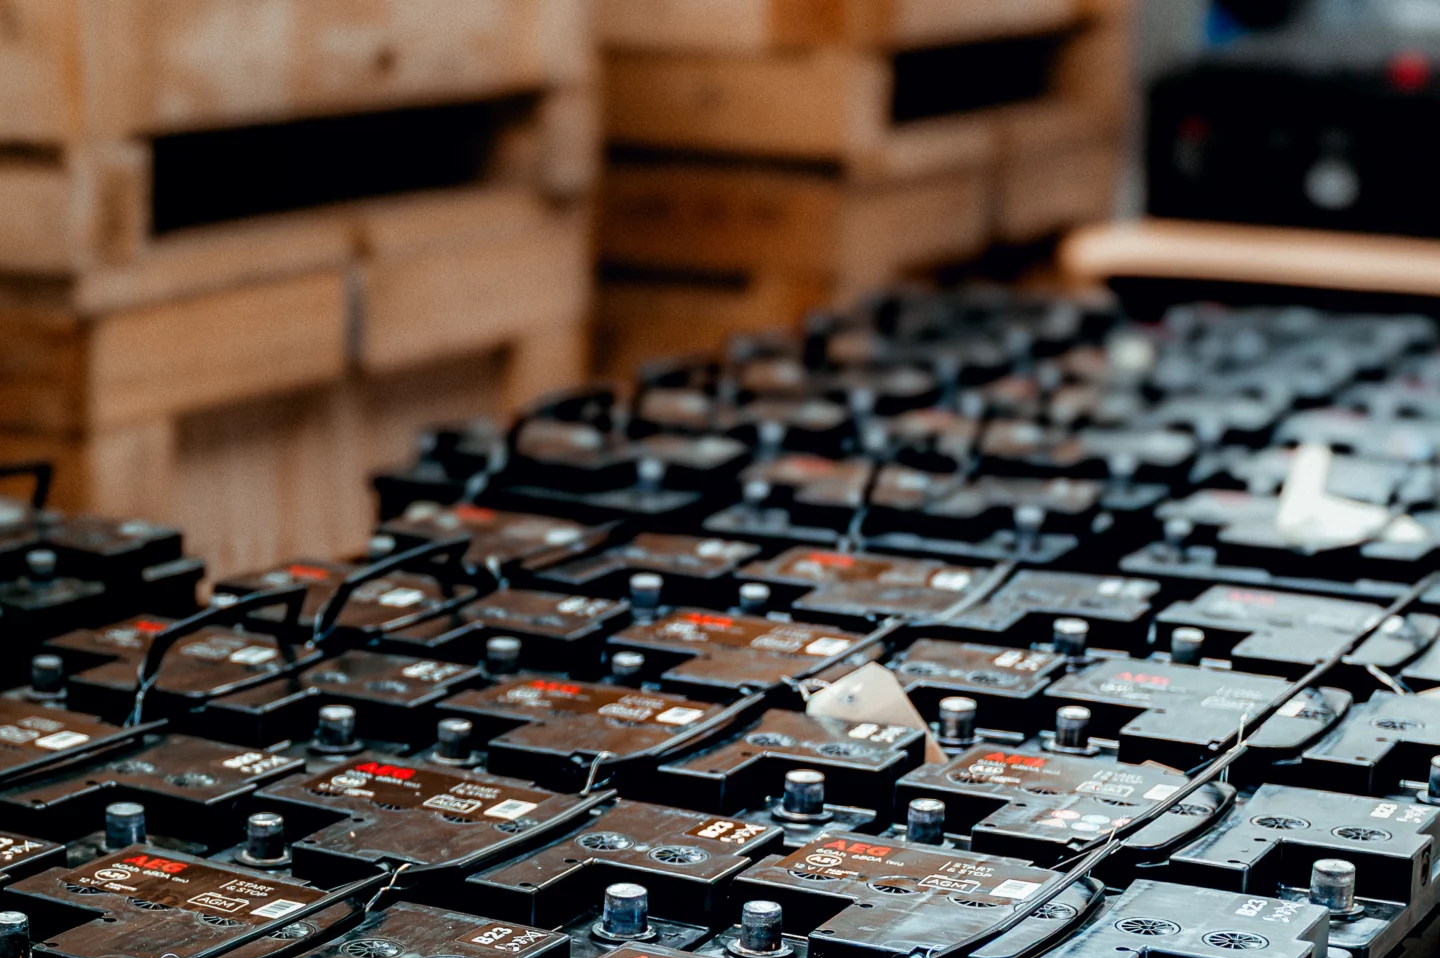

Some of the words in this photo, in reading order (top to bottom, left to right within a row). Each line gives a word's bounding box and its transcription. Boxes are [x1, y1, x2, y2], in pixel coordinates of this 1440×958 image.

[824, 839, 893, 857] AEG
[123, 855, 188, 873] AEG
[235, 880, 275, 893] START
[926, 879, 968, 890] AGM
[237, 886, 268, 897] STOP
[197, 896, 235, 909] AGM
[471, 927, 513, 945] B23
